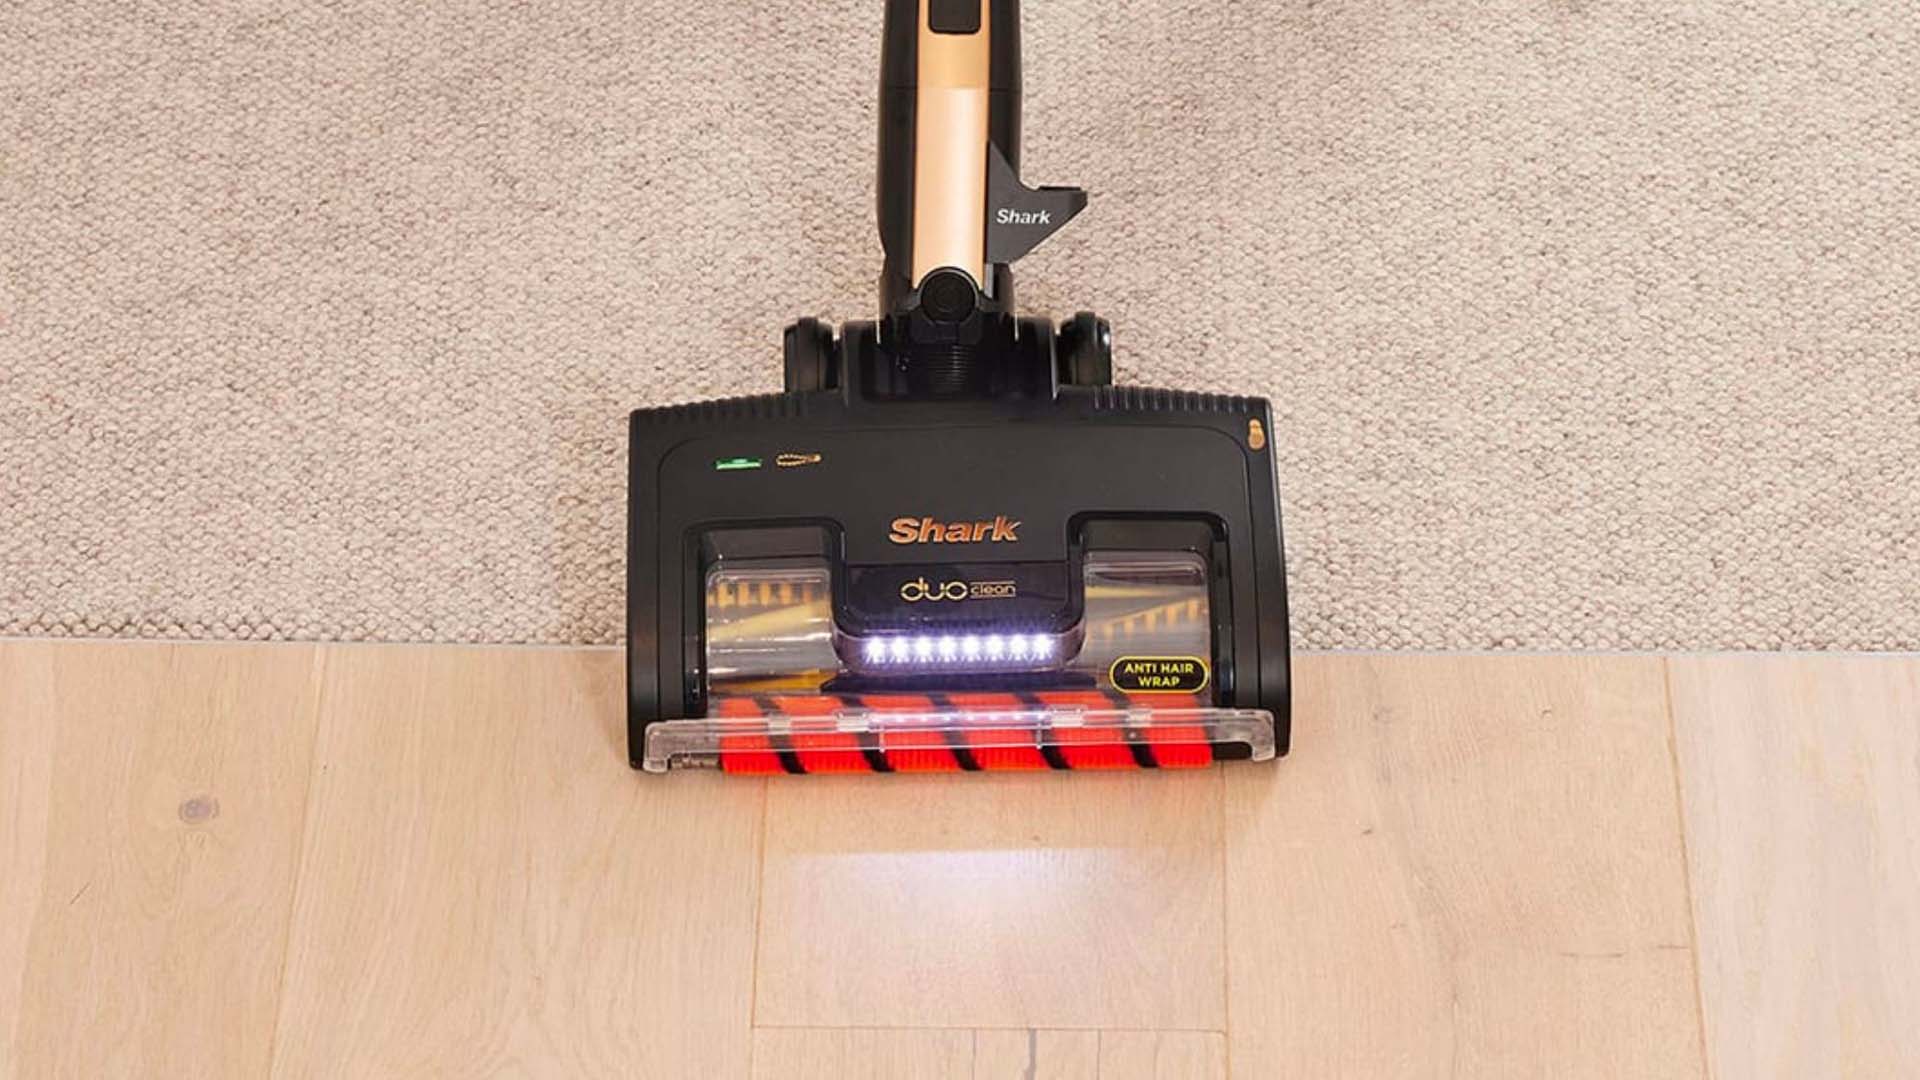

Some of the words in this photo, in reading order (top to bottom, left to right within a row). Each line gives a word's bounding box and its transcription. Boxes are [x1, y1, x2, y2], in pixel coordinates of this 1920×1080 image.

[996, 207, 1051, 225] Shark
[889, 515, 1022, 544] Shark
[901, 576, 968, 601] duo
[970, 582, 1017, 597] clean
[1124, 662, 1158, 674] ANTI
[1160, 662, 1195, 674] HAIR
[1138, 675, 1181, 688] WRAP
